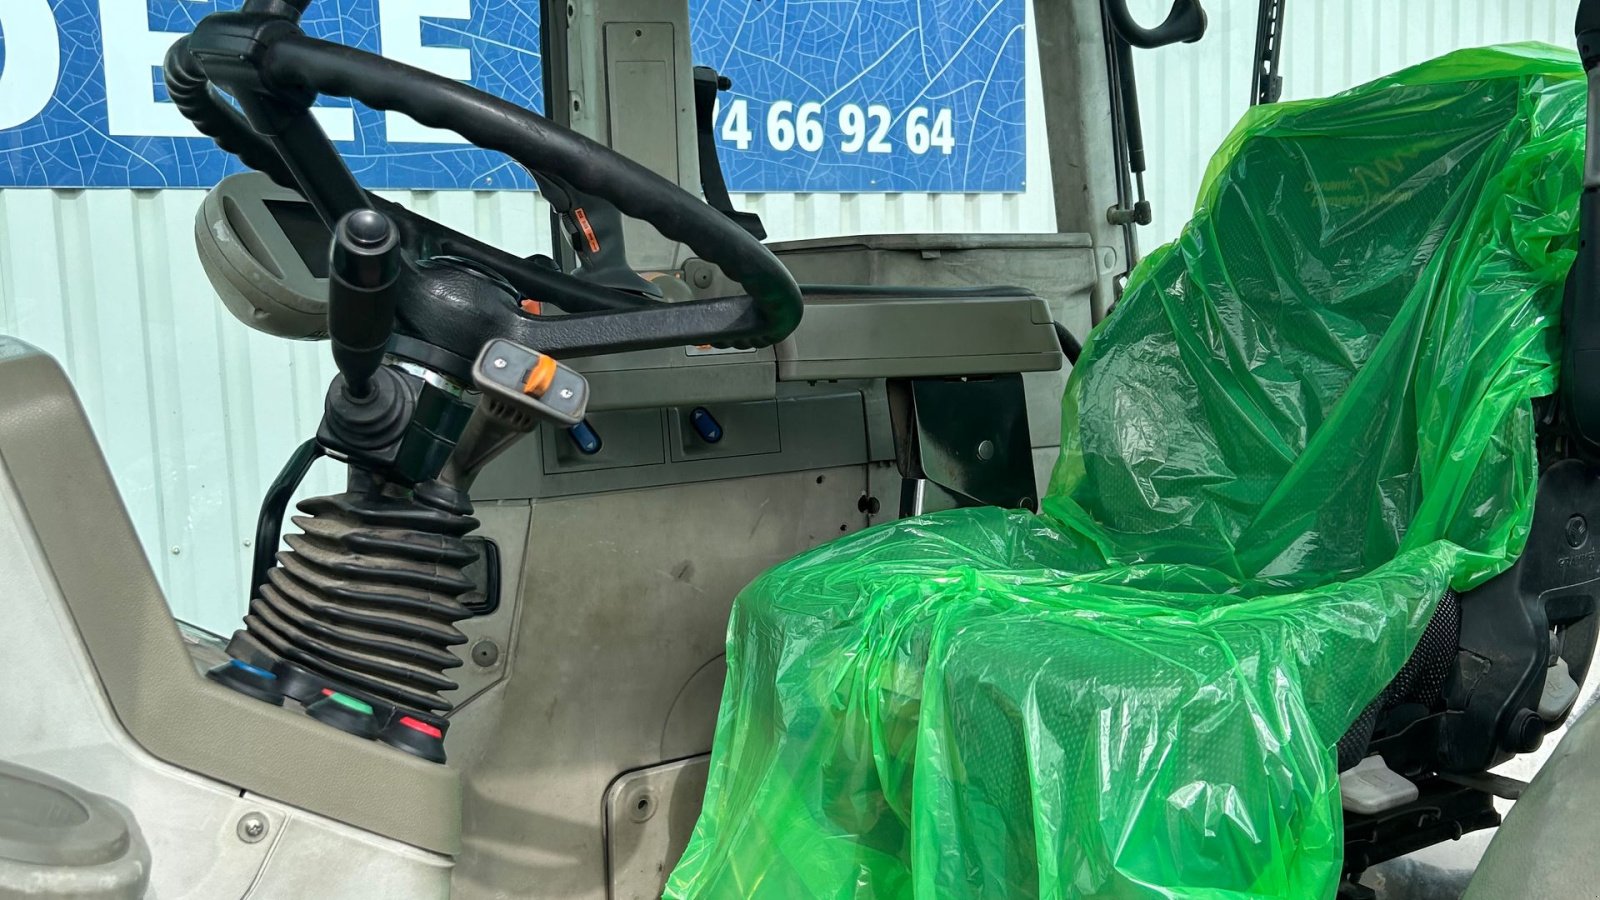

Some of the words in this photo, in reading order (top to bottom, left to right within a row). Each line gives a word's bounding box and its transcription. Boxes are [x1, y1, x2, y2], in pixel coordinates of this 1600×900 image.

[712, 97, 752, 150] 4
[767, 100, 824, 151] 66
[838, 104, 892, 153] 92
[906, 107, 955, 154] 64
